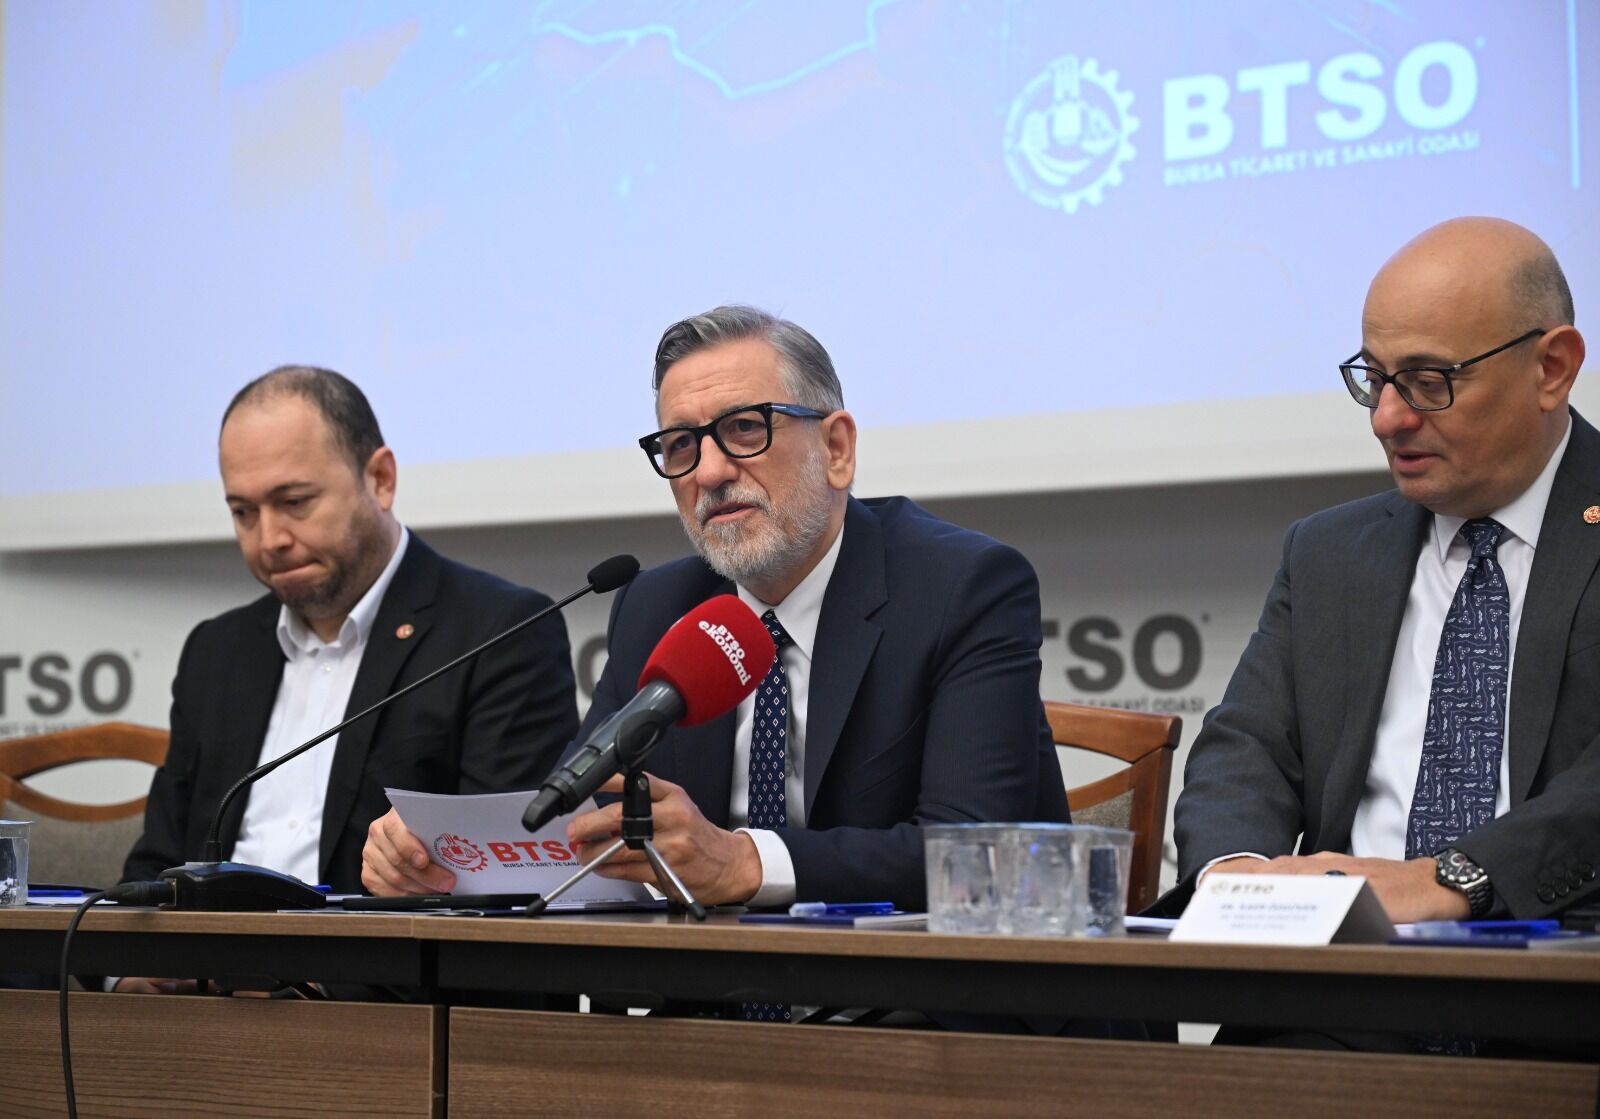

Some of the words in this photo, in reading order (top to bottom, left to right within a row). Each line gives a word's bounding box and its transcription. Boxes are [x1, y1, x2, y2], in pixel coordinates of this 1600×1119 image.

[1163, 41, 1478, 161] BTSO
[1163, 162, 1225, 187] BURSA
[1312, 148, 1336, 168] VE
[1418, 130, 1481, 156] ODASI
[699, 620, 751, 686] ekonomi
[717, 625, 745, 659] BTSO
[1041, 613, 1203, 692] SO
